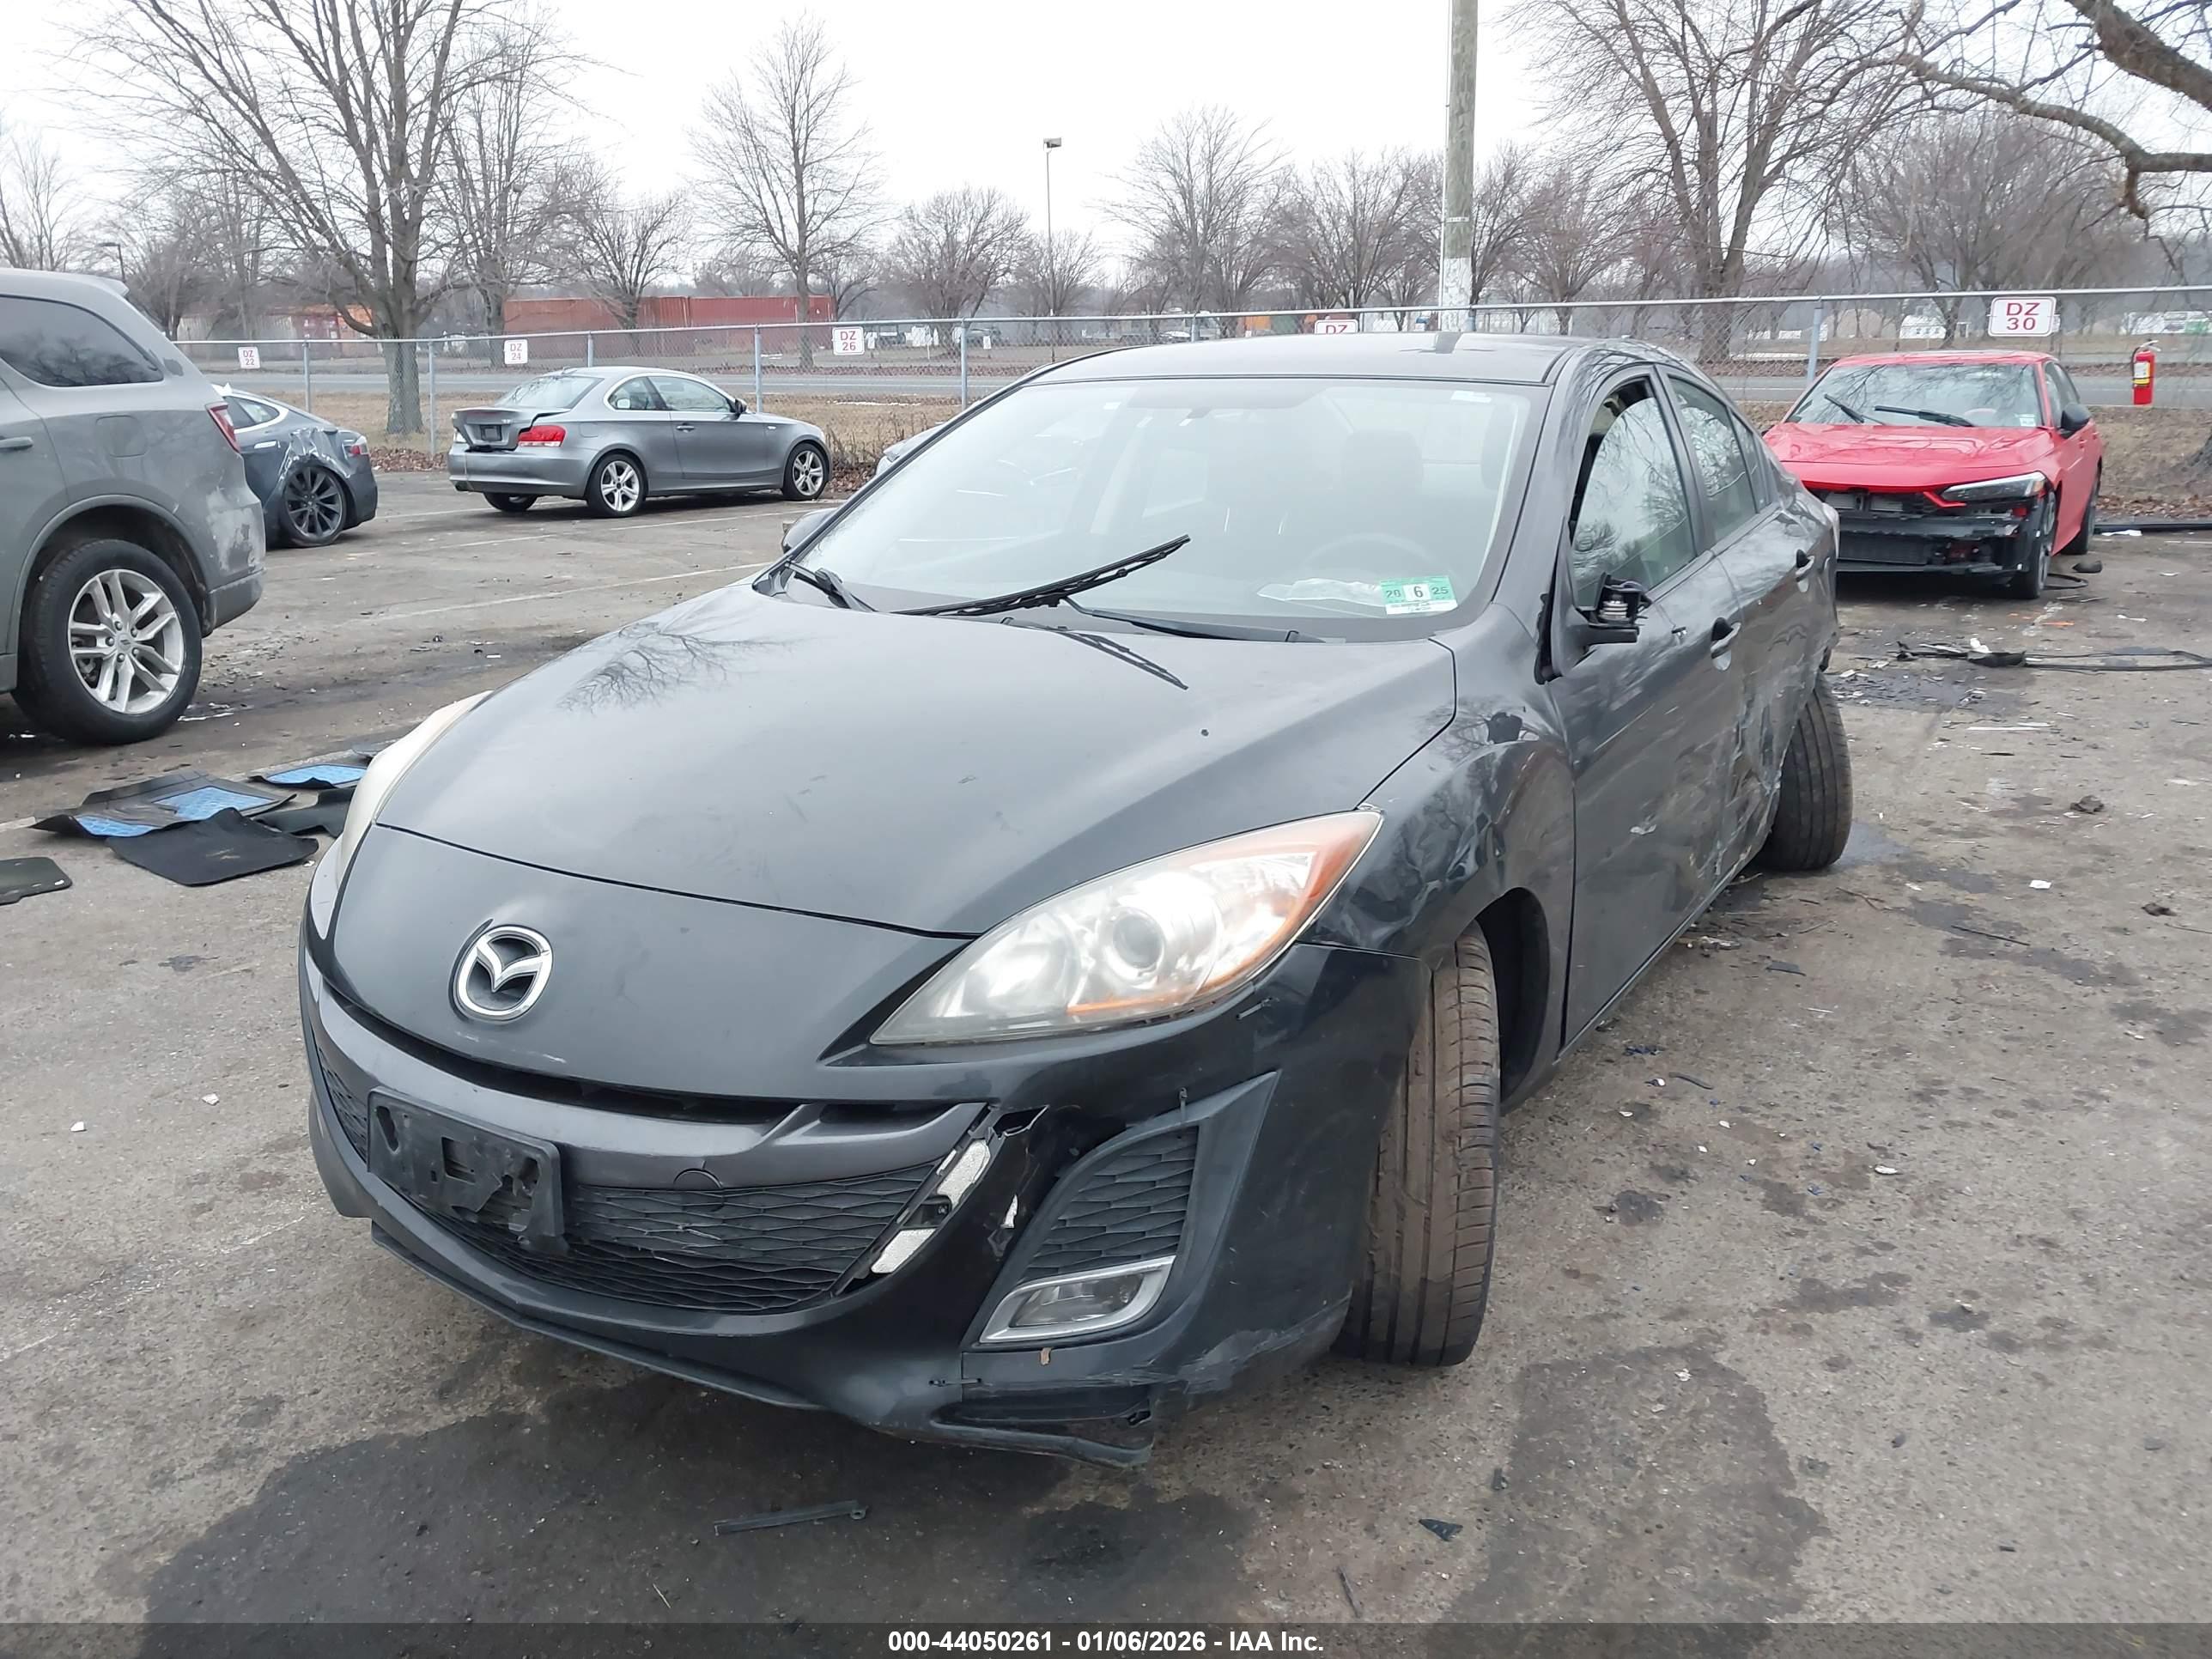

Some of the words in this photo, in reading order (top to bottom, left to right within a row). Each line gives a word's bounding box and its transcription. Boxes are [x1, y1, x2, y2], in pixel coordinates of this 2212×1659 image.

[2006, 302, 2041, 316] DZ
[2006, 317, 2036, 331] 30
[840, 331, 857, 341] DZ
[510, 343, 523, 352] DZ
[842, 342, 856, 351] 26
[242, 349, 254, 358] DZ
[511, 352, 521, 361] 24
[1413, 586, 1424, 598] 6
[1431, 586, 1449, 595] 25
